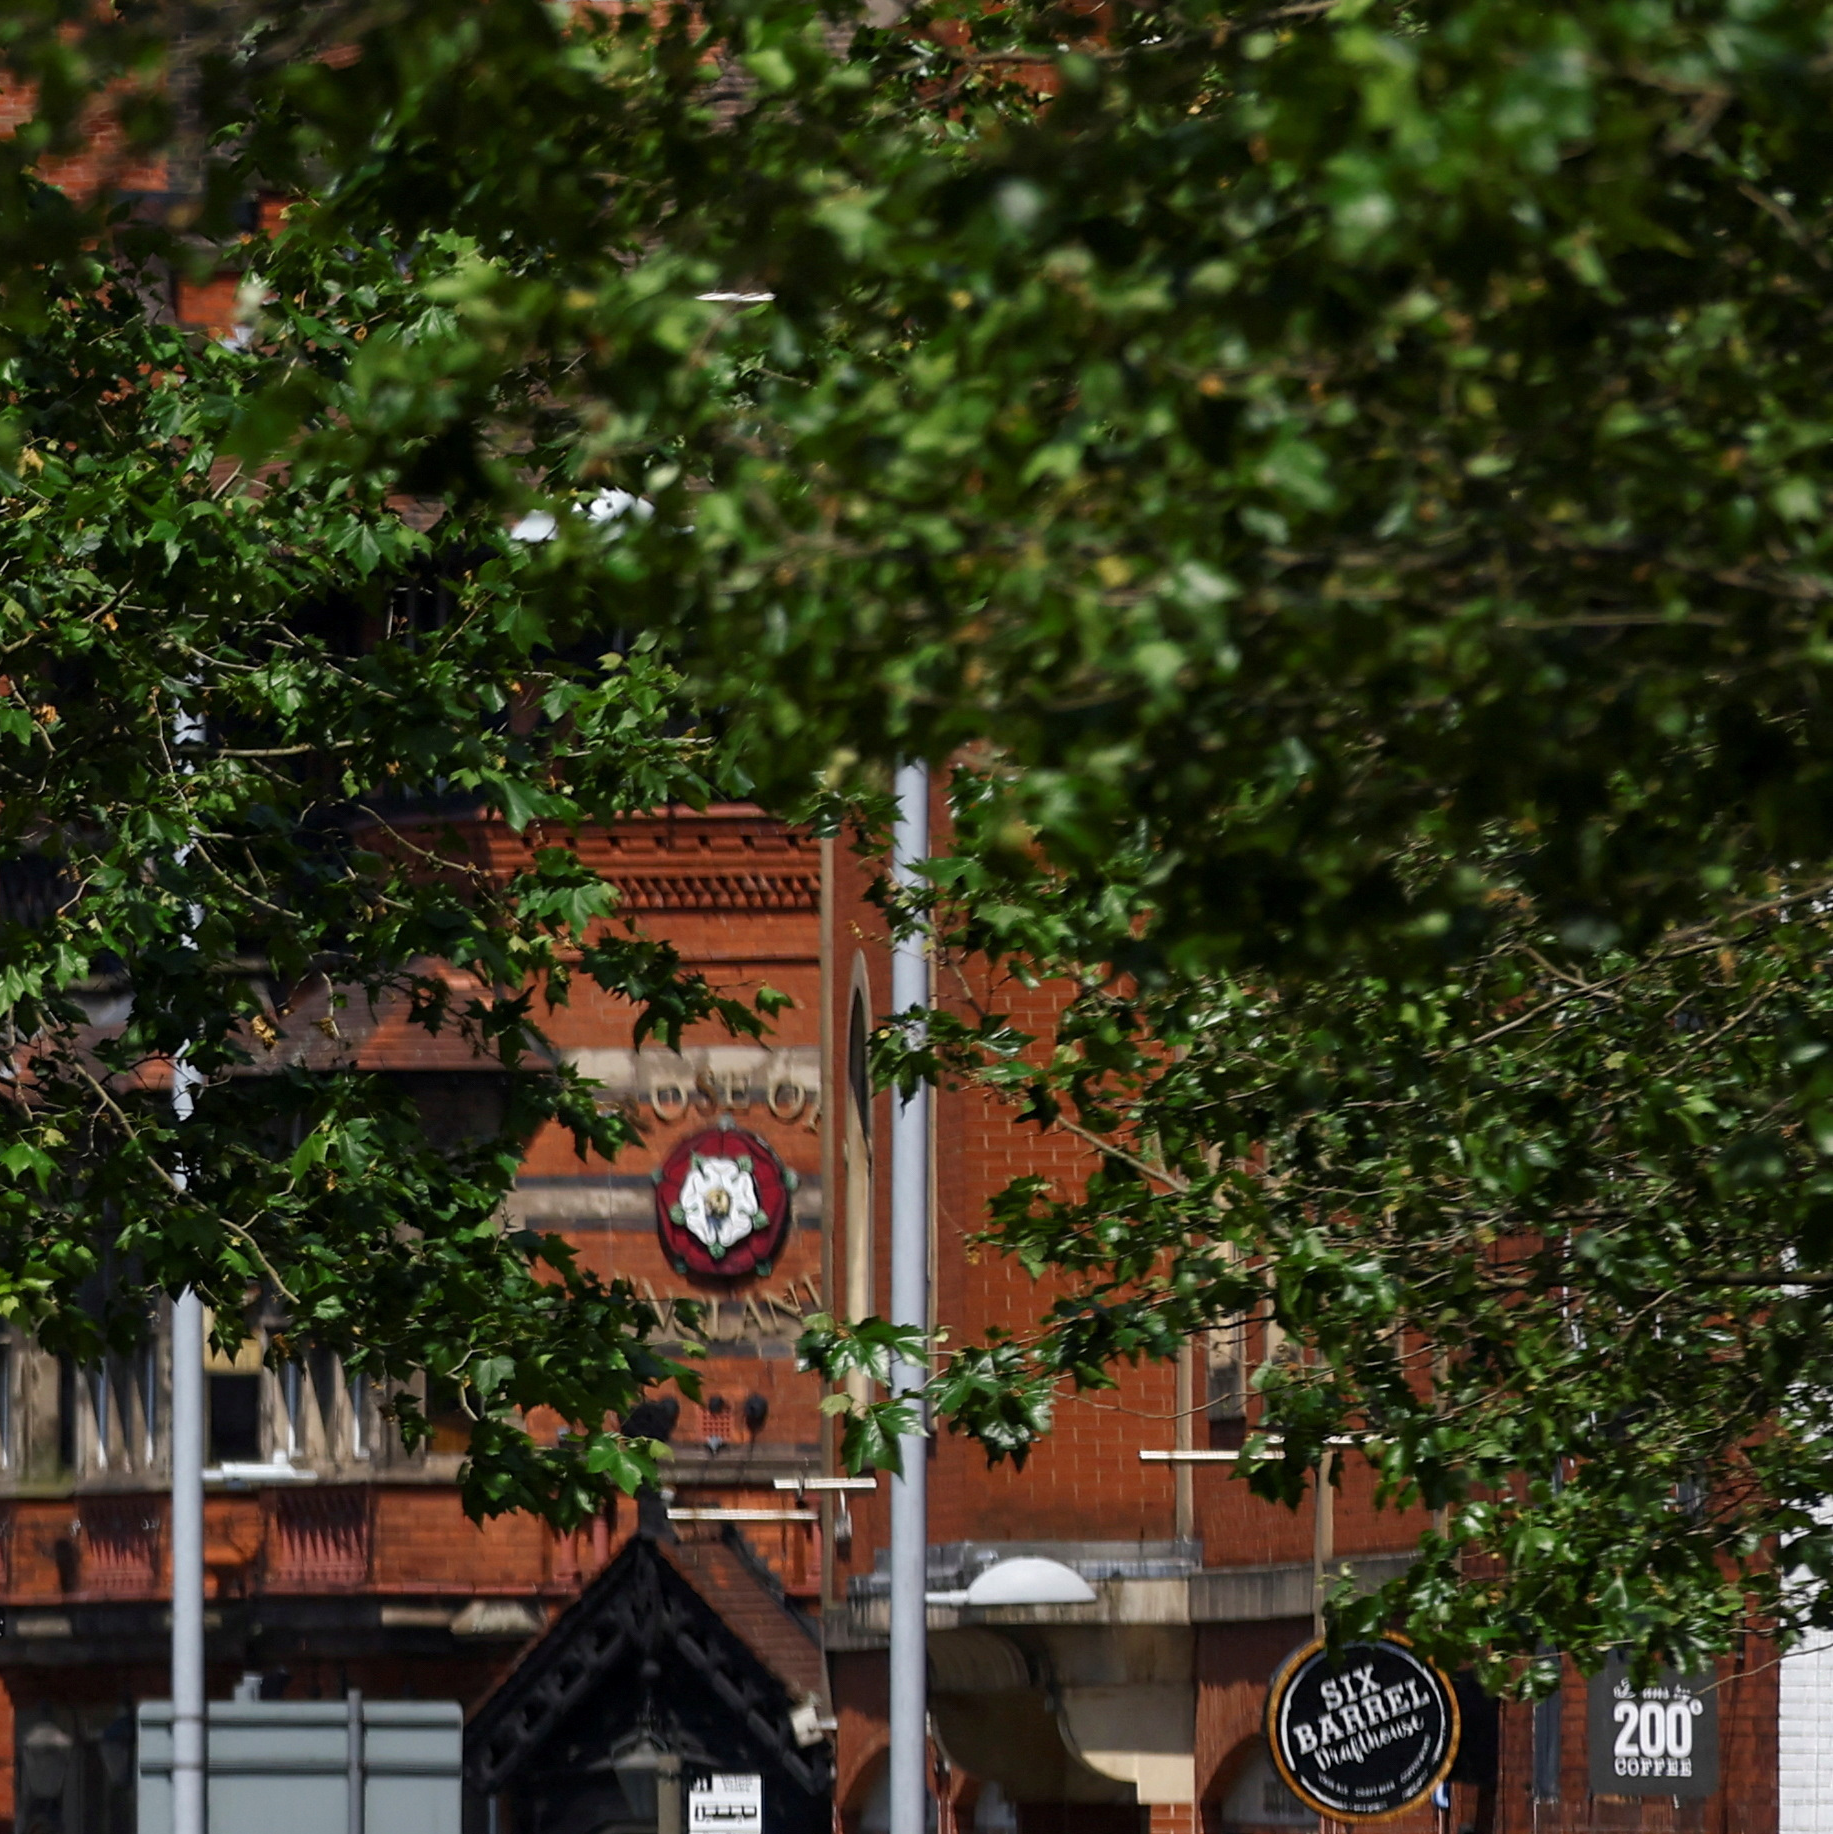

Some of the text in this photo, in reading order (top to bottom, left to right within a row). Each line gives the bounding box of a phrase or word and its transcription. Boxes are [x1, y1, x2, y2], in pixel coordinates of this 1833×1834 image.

[624, 1068, 752, 1133] OSE
[1320, 1662, 1382, 1711] SIX
[1293, 1677, 1431, 1755] BARREL
[1314, 1714, 1425, 1772] Drafthouse
[1614, 1757, 1693, 1777] COFFEE
